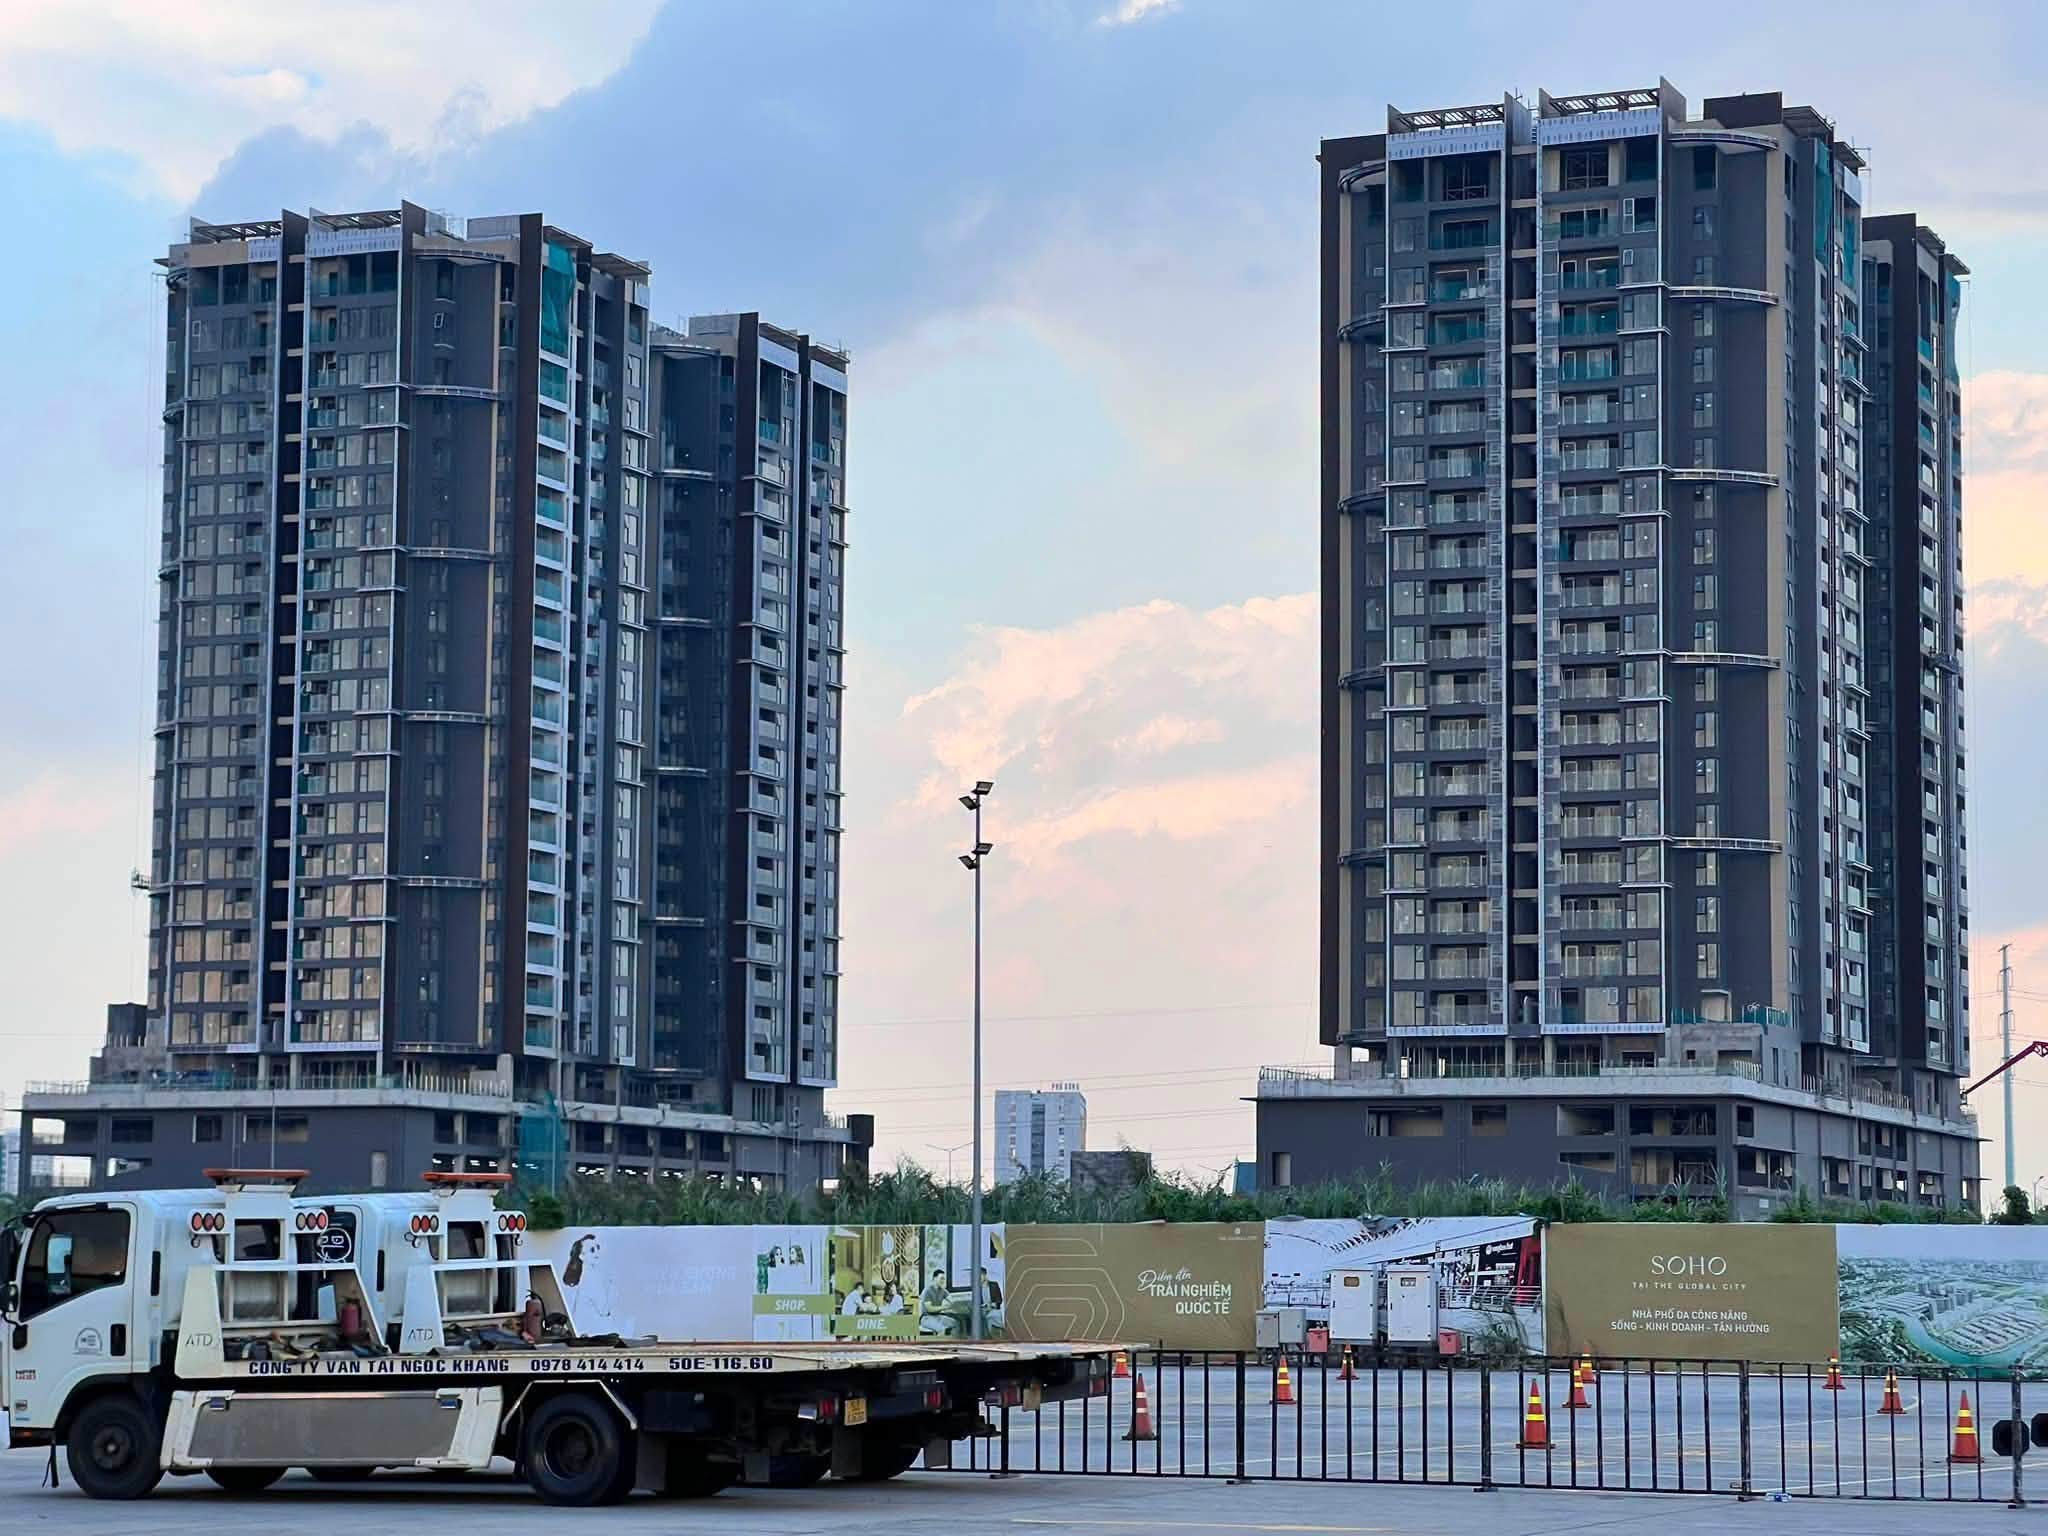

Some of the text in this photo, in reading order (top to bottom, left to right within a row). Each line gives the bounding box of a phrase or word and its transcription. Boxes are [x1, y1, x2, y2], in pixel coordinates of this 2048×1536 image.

[1650, 1255, 1727, 1276] SOHO
[1180, 1280, 1232, 1299] NGHIỆM
[1654, 1282, 1673, 1290] THE
[1678, 1282, 1718, 1291] GLOBAL
[1722, 1283, 1747, 1291] CITY
[775, 1299, 807, 1312] SHOP.
[1175, 1297, 1231, 1315] QUỐC TẾ
[1691, 1308, 1719, 1320] CÔNG
[857, 1318, 887, 1330] DINE.
[1645, 1321, 1669, 1332] KINH
[1671, 1322, 1705, 1333] DOANH
[300, 1360, 319, 1374] TY
[452, 1359, 509, 1372] KHANG
[530, 1358, 571, 1371] 0978
[577, 1358, 608, 1371] 414
[613, 1357, 645, 1370] 414
[669, 1357, 773, 1370] 50E-116.60
